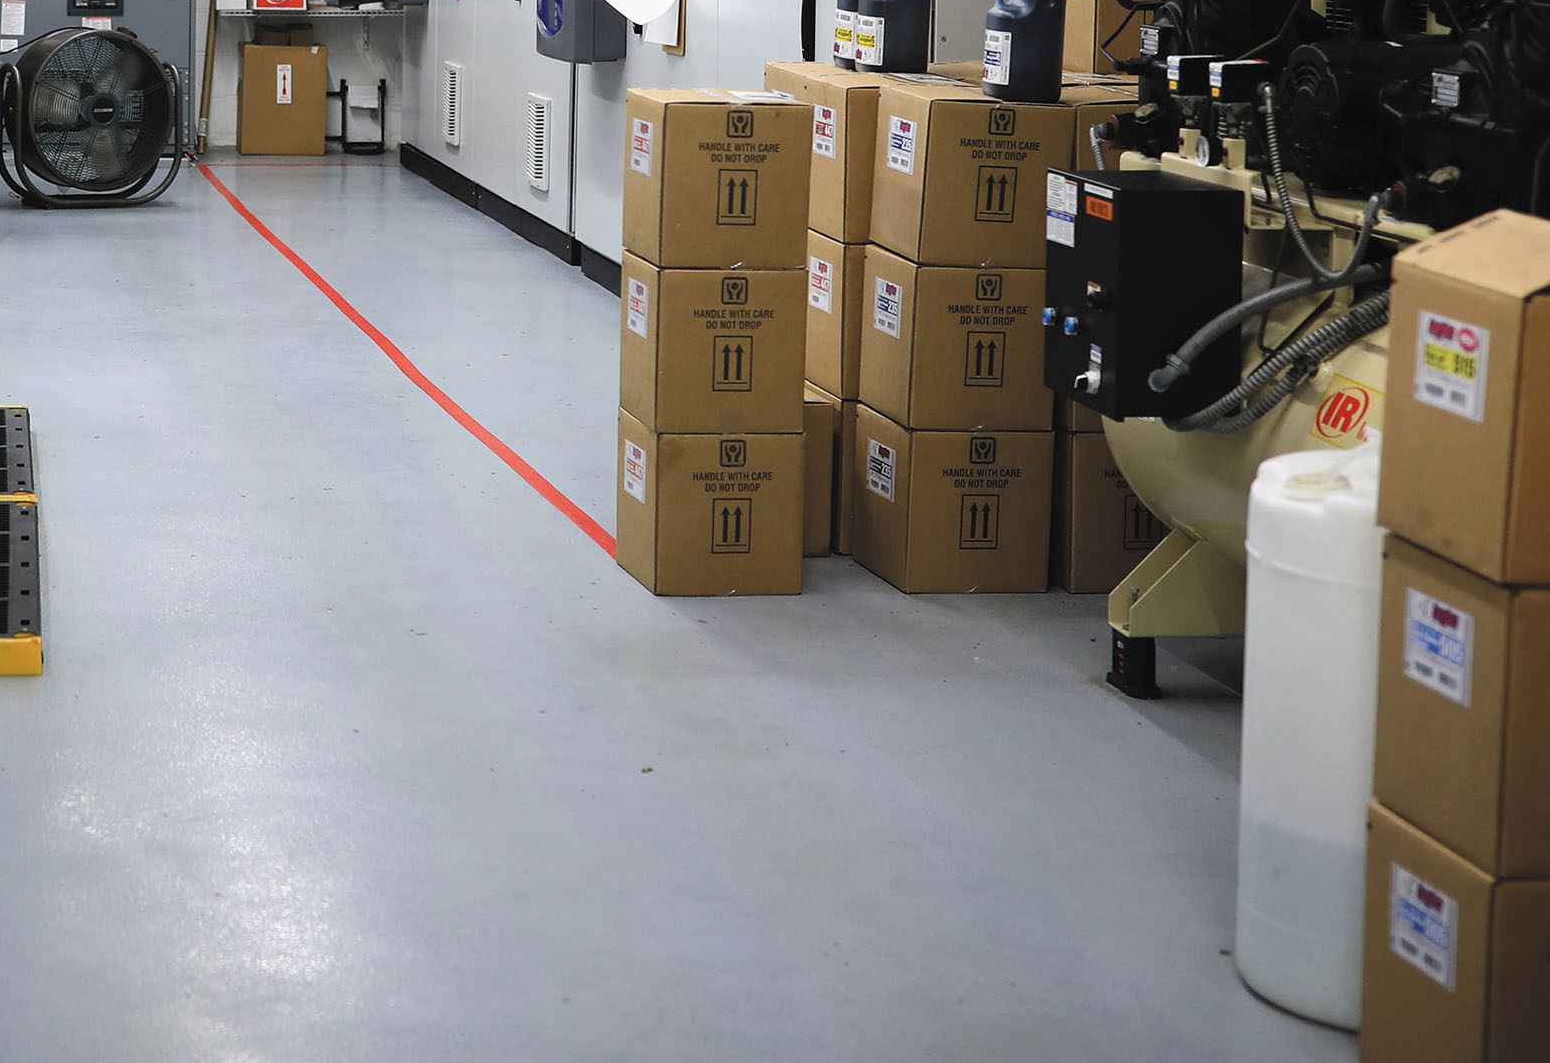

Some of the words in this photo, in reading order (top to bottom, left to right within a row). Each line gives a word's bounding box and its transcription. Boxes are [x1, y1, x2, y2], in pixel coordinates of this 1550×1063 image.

[699, 142, 732, 151] HANDLE
[735, 143, 755, 152] WITH
[758, 143, 780, 152] CARE
[960, 138, 993, 148] HANDLE
[995, 140, 1016, 149] WITH
[1018, 141, 1041, 151] CARE
[711, 154, 723, 162] DO
[725, 154, 741, 162] NOT
[744, 154, 767, 163] DROP
[972, 150, 983, 159] DO
[986, 151, 1002, 160] NOT
[1004, 152, 1027, 161] DROP
[693, 309, 727, 318] HANDLE
[729, 309, 750, 318] WITH
[752, 309, 775, 318] CARE
[948, 305, 981, 314] HANDLE
[983, 305, 1004, 314] WITH
[1006, 306, 1027, 315] CARE
[706, 321, 718, 329] DO
[720, 321, 737, 329] NOT
[739, 321, 762, 329] DROP
[960, 316, 971, 324] DO
[974, 316, 990, 325] NOT
[992, 317, 1015, 325] DROP
[1322, 391, 1360, 433] IR
[692, 472, 725, 481] HANDLE
[728, 472, 749, 481] WITH
[751, 472, 773, 480] CARE
[943, 468, 975, 477] HANDLE
[977, 468, 998, 477] WITH
[1000, 468, 1021, 477] CARE
[705, 483, 717, 492] DO
[719, 483, 735, 492] NOT
[738, 483, 760, 492] DROP
[954, 479, 966, 488] DO
[968, 479, 983, 488] NOT
[986, 479, 1009, 488] DROP
